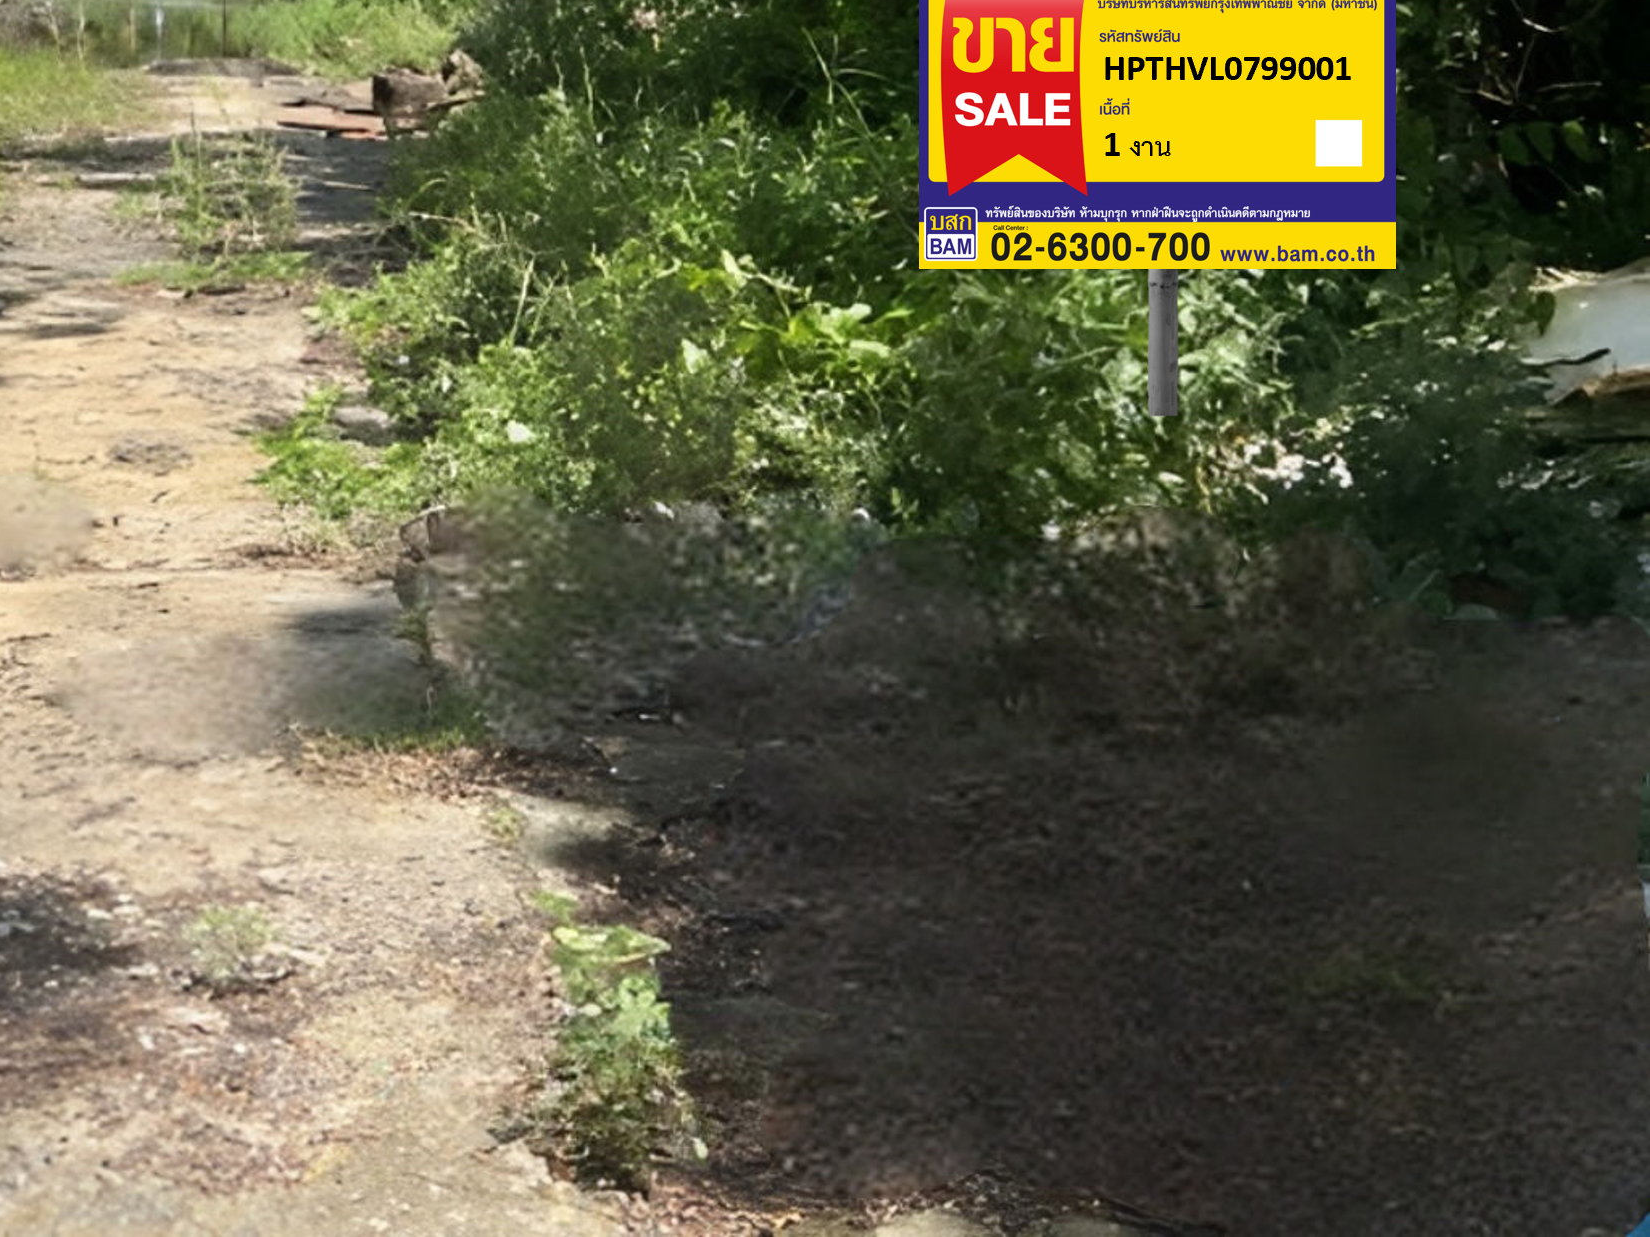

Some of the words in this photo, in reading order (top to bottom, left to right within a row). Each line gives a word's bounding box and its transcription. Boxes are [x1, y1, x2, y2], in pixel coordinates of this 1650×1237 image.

[952, 16, 1075, 74] ขาย
[1099, 29, 1181, 43] รหัสทรัพย์สิน
[1104, 56, 1352, 81] HPTHVL0799001
[954, 92, 1072, 127] SALE
[1099, 98, 1131, 116] เนื้อที่
[1104, 132, 1121, 157] 1
[1129, 140, 1172, 157] งาน
[929, 213, 972, 231] บสก
[985, 205, 1076, 218] ทรัพย์สินของบริษัท
[1079, 206, 1127, 222] ห้ามบุกรุก
[930, 237, 972, 255] BAM
[991, 232, 1211, 262] 02-6300-700
[1220, 245, 1375, 262] www.bam.co.th
